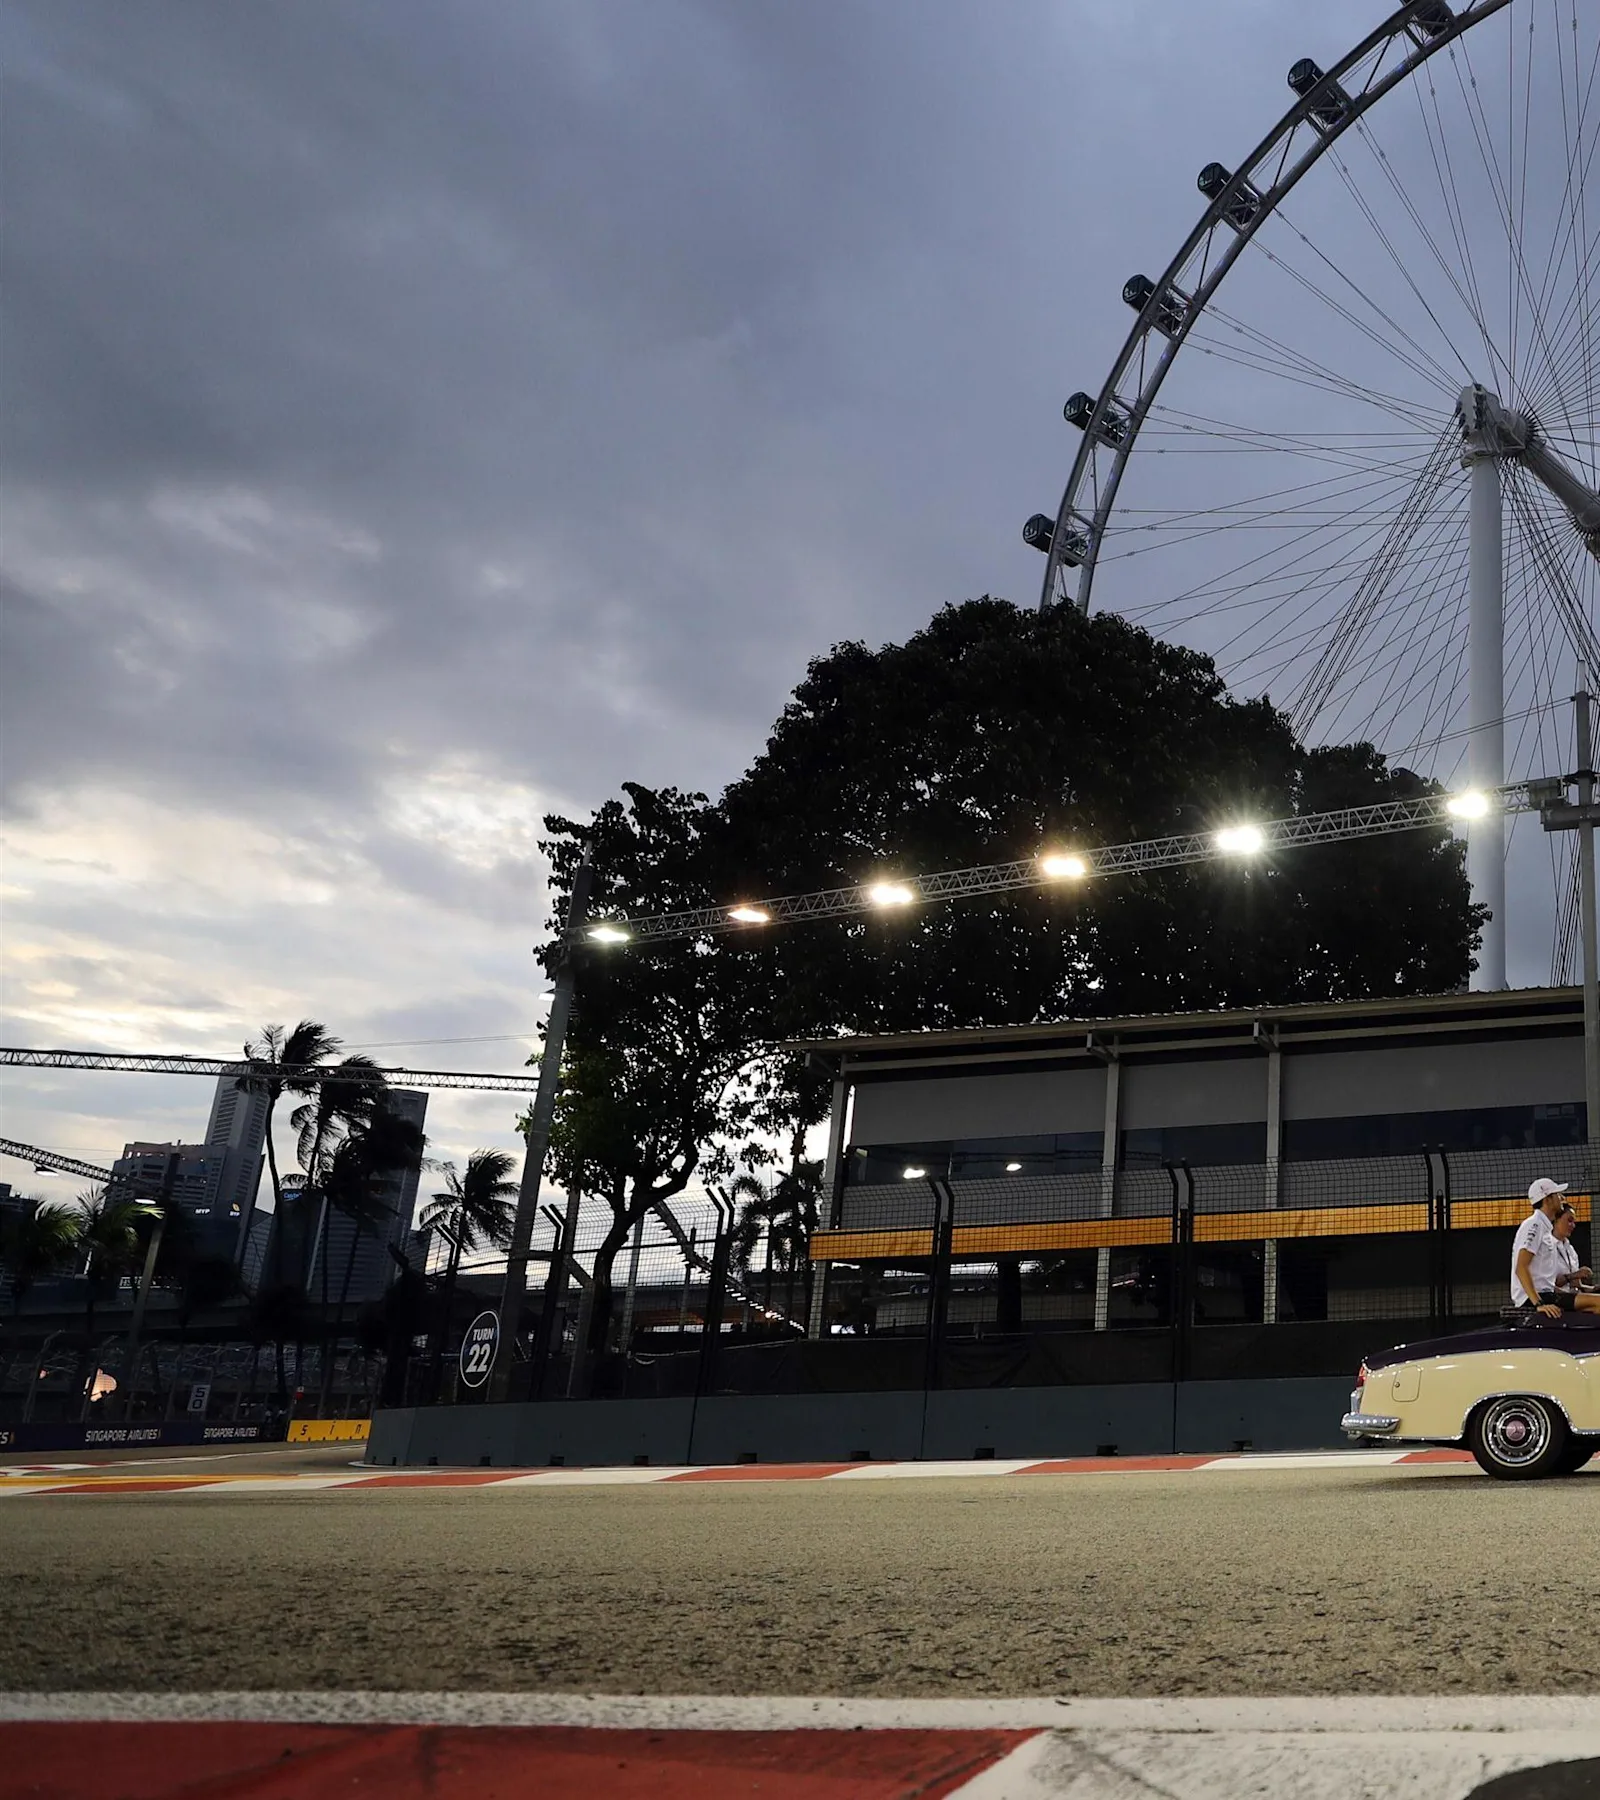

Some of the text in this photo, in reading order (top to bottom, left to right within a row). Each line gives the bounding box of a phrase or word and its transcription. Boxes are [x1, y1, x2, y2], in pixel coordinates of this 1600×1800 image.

[473, 1327, 494, 1341] TURN
[465, 1343, 491, 1373] 22
[84, 1428, 158, 1442] SINGAPORE AIRLINES
[203, 1427, 258, 1438] SINGAPORE AIRLINES
